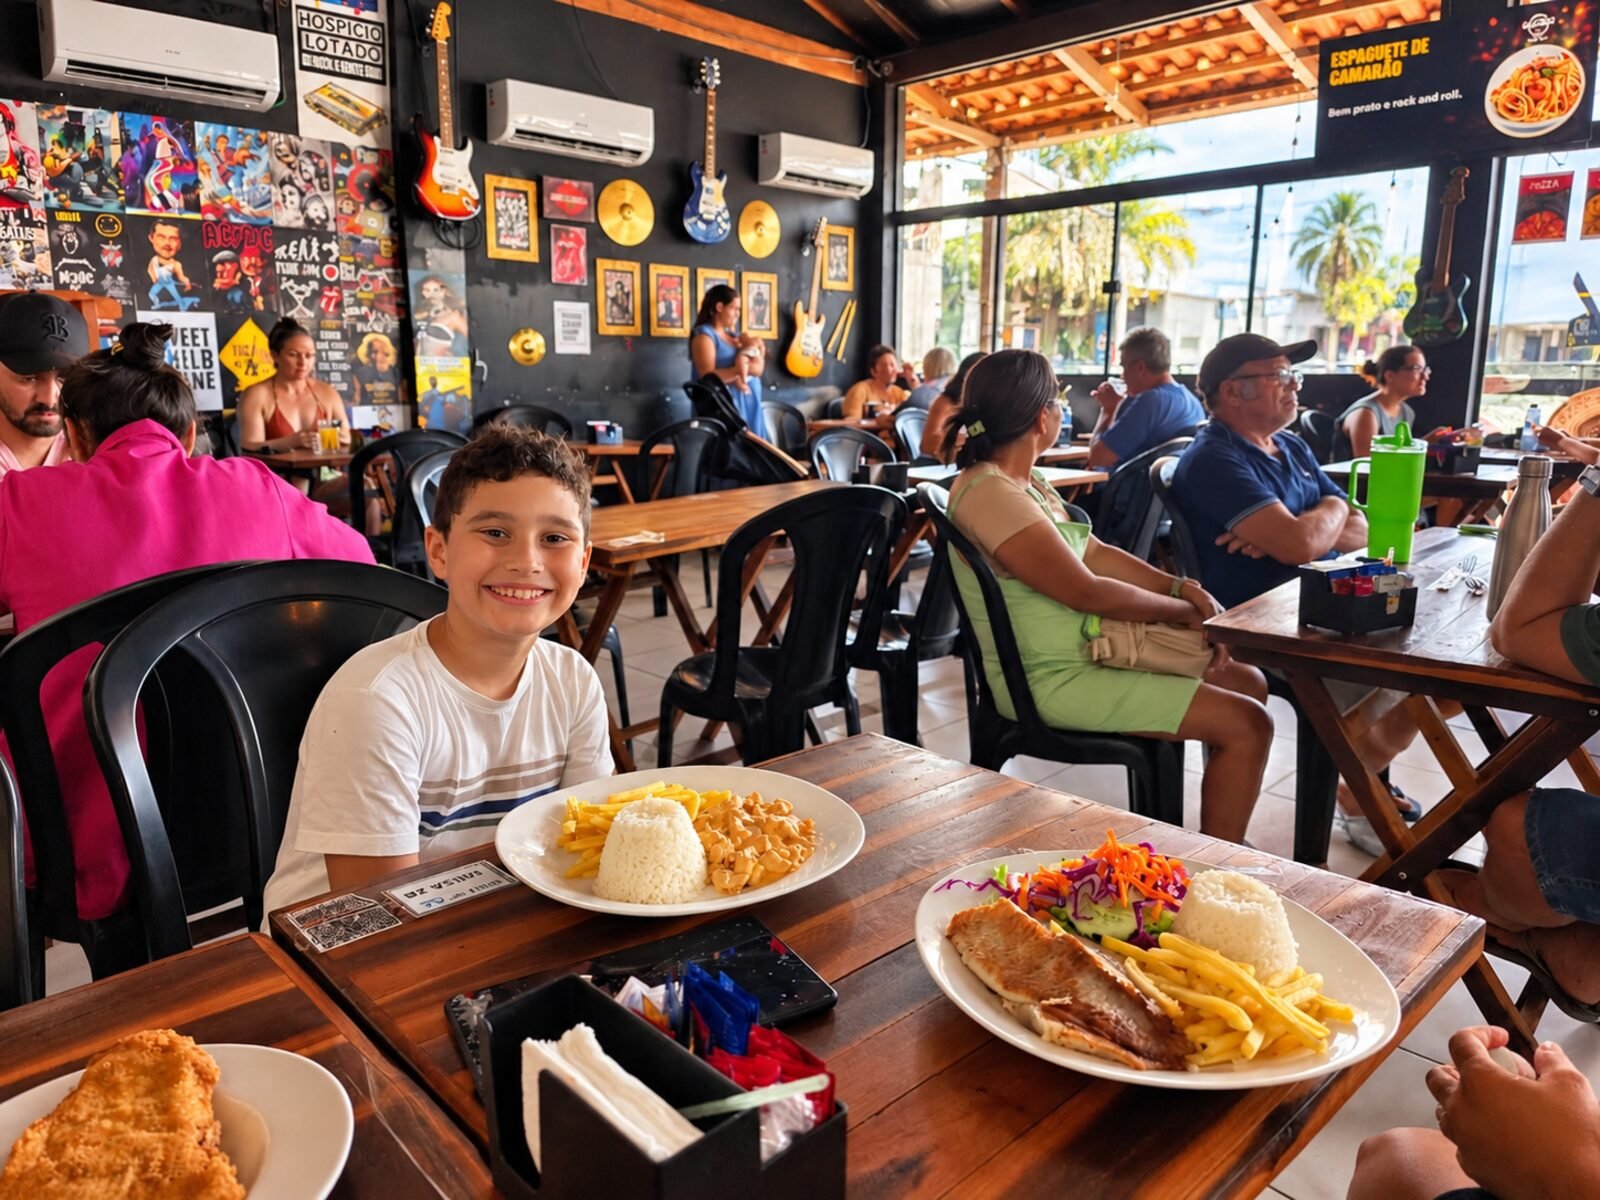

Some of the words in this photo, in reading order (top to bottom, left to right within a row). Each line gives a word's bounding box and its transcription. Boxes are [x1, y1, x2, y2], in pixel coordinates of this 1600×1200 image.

[299, 11, 381, 41] HOSPICIO
[304, 33, 381, 62] LOTADO
[1330, 41, 1409, 68] ESPAGUETE
[1410, 37, 1430, 55] DE
[1328, 58, 1403, 86] CAMARÃO
[1327, 107, 1351, 118] Bem
[1352, 102, 1381, 116] prato
[1383, 101, 1391, 109] e
[1392, 95, 1416, 108] rock
[1417, 92, 1439, 104] and
[1440, 88, 1463, 101] roll.
[184, 371, 216, 390] NE
